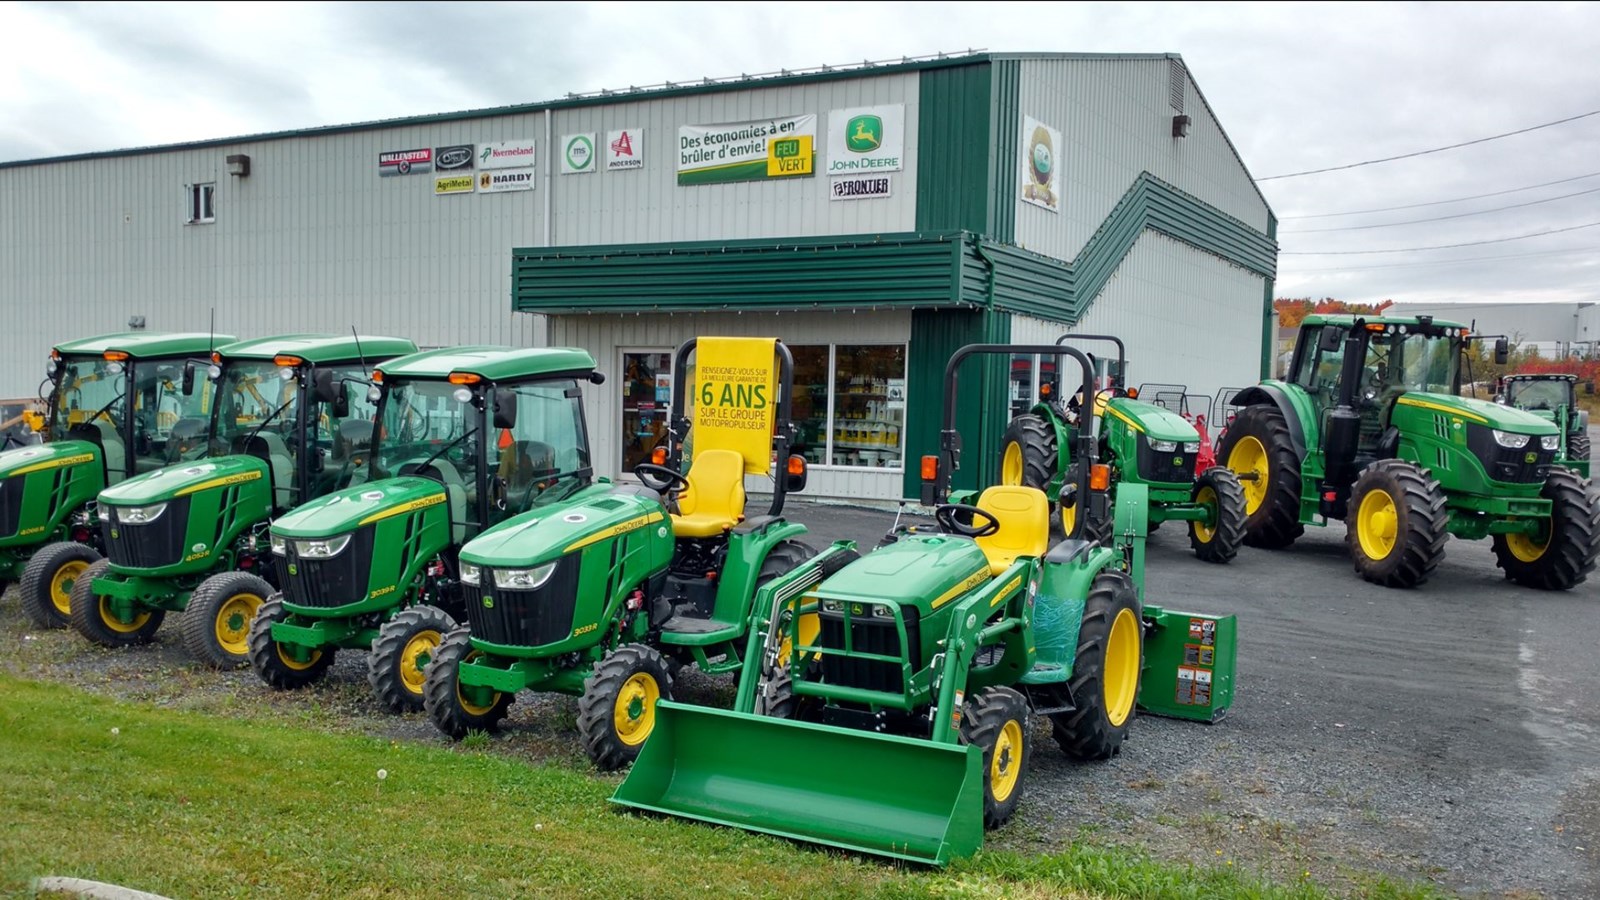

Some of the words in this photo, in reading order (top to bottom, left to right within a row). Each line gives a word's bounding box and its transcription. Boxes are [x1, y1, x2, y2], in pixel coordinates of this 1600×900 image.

[681, 136, 701, 149] Des
[704, 125, 767, 146] économies
[769, 121, 777, 135] à
[780, 121, 796, 132] en
[681, 148, 715, 165] brûler
[718, 138, 766, 159] d'envie!
[776, 141, 797, 156] FEU
[380, 150, 429, 162] WALLENSTEIN
[609, 160, 642, 168] ANDERSON
[778, 158, 806, 172] VERT
[829, 160, 859, 171] JOHN
[861, 157, 899, 169] DEERE
[437, 179, 472, 191] AgriMetal
[493, 173, 532, 184] HARDY
[843, 178, 889, 196] FRONTIER
[701, 366, 754, 376] RENSEIGNEZ-VOUS
[755, 368, 768, 376] SUR
[701, 382, 714, 406] 6
[719, 383, 767, 409] ANS
[700, 407, 716, 418] SUR
[717, 408, 728, 419] LE
[730, 408, 766, 421] GROUPE
[700, 418, 766, 430] MOTOPROPULSEUR
[410, 500, 425, 510] JOHN
[425, 495, 443, 505] DEERE
[613, 525, 628, 535] JOHN
[628, 518, 644, 529] DEERE
[977, 568, 989, 582] DEERE
